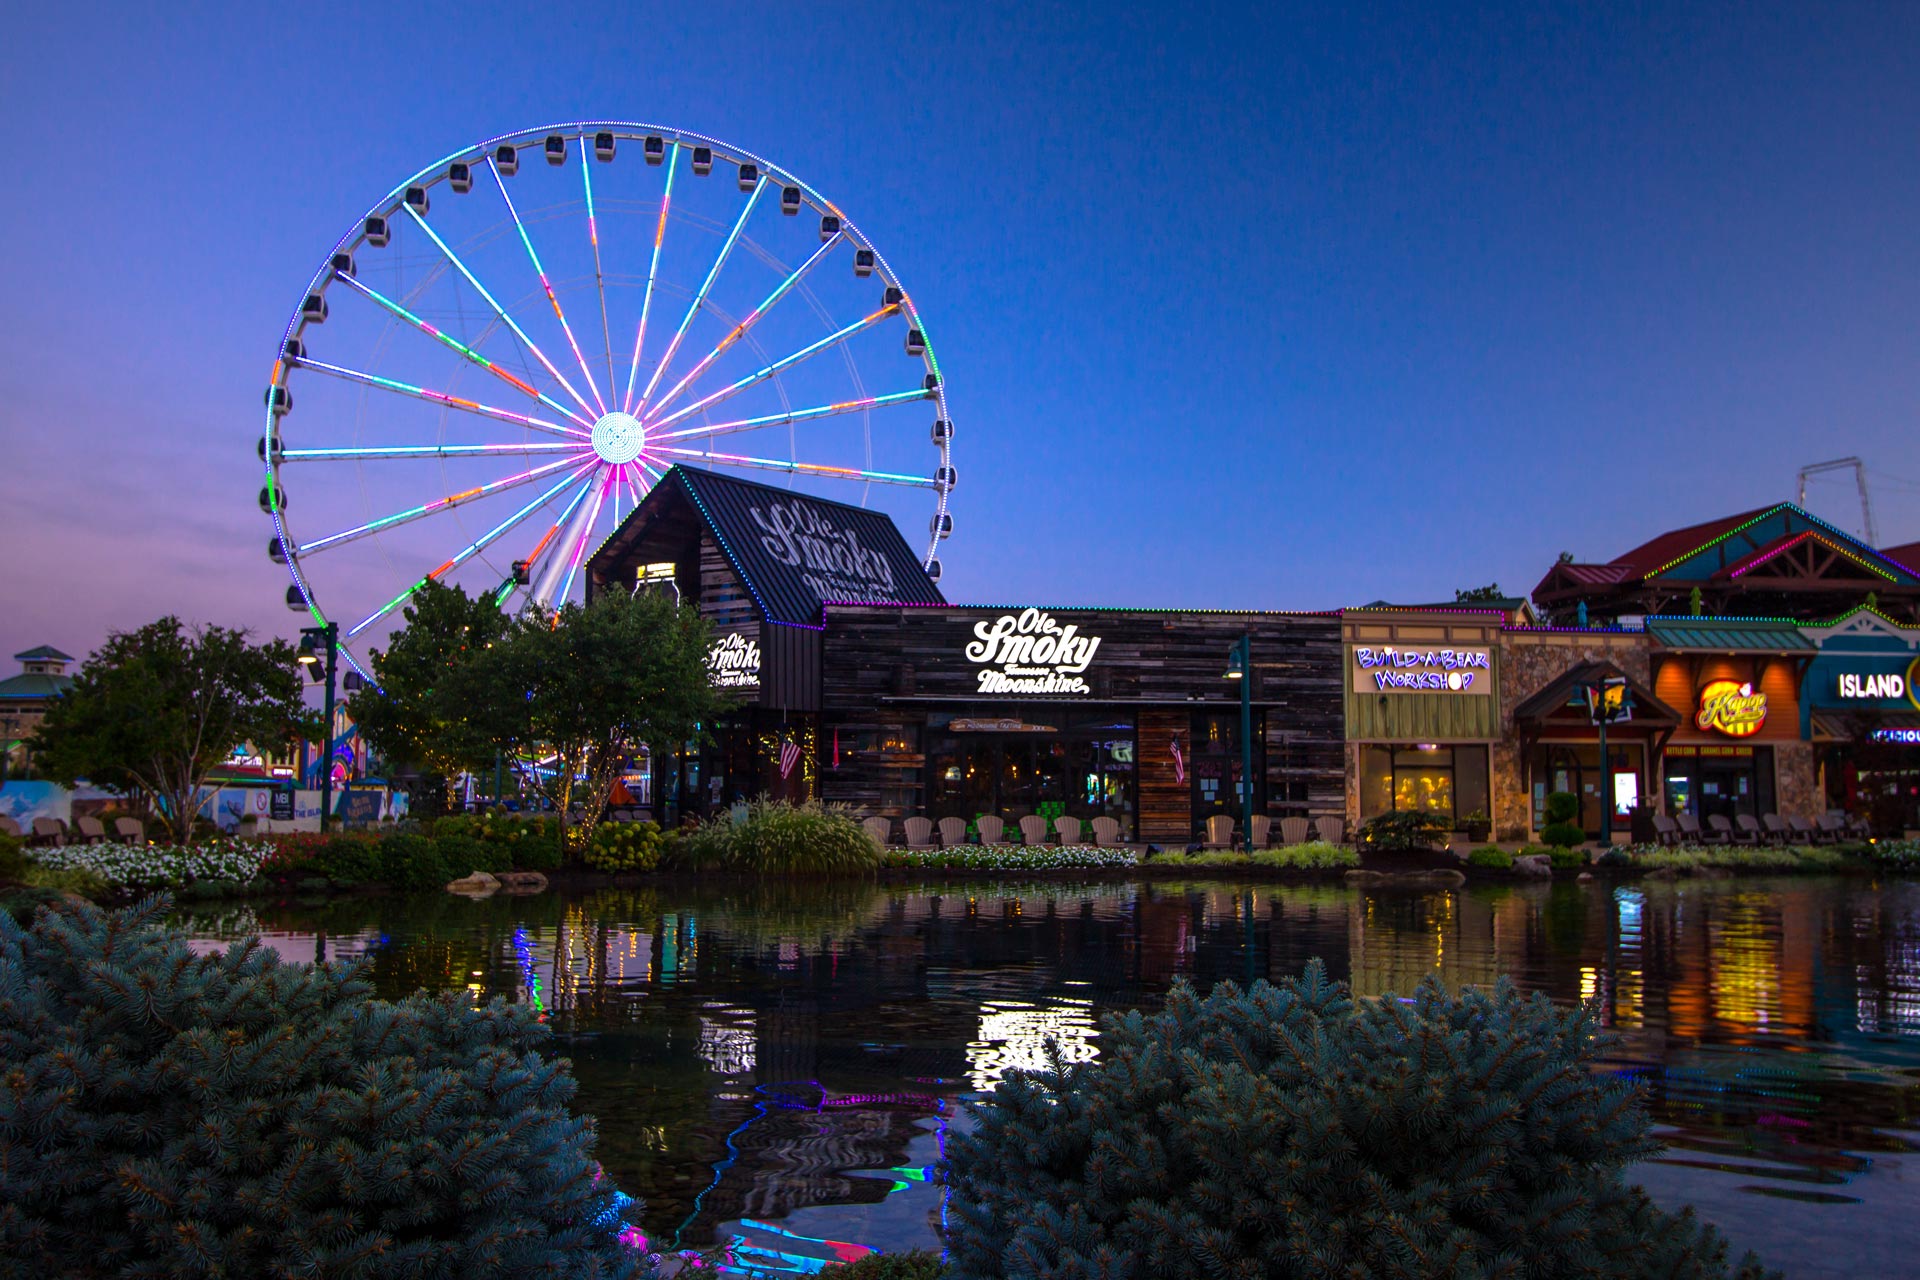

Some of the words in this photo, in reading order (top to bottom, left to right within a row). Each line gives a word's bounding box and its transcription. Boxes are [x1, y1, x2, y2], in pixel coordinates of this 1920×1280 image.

[790, 499, 840, 539] Ole
[750, 503, 894, 593] Smoky
[1017, 607, 1063, 637] Ole
[726, 632, 748, 650] Ole
[965, 614, 1102, 674] Smoky
[977, 669, 1090, 695] Moonshine
[1374, 669, 1474, 691] WORKSHOP
[1839, 673, 1905, 698] ISLAND
